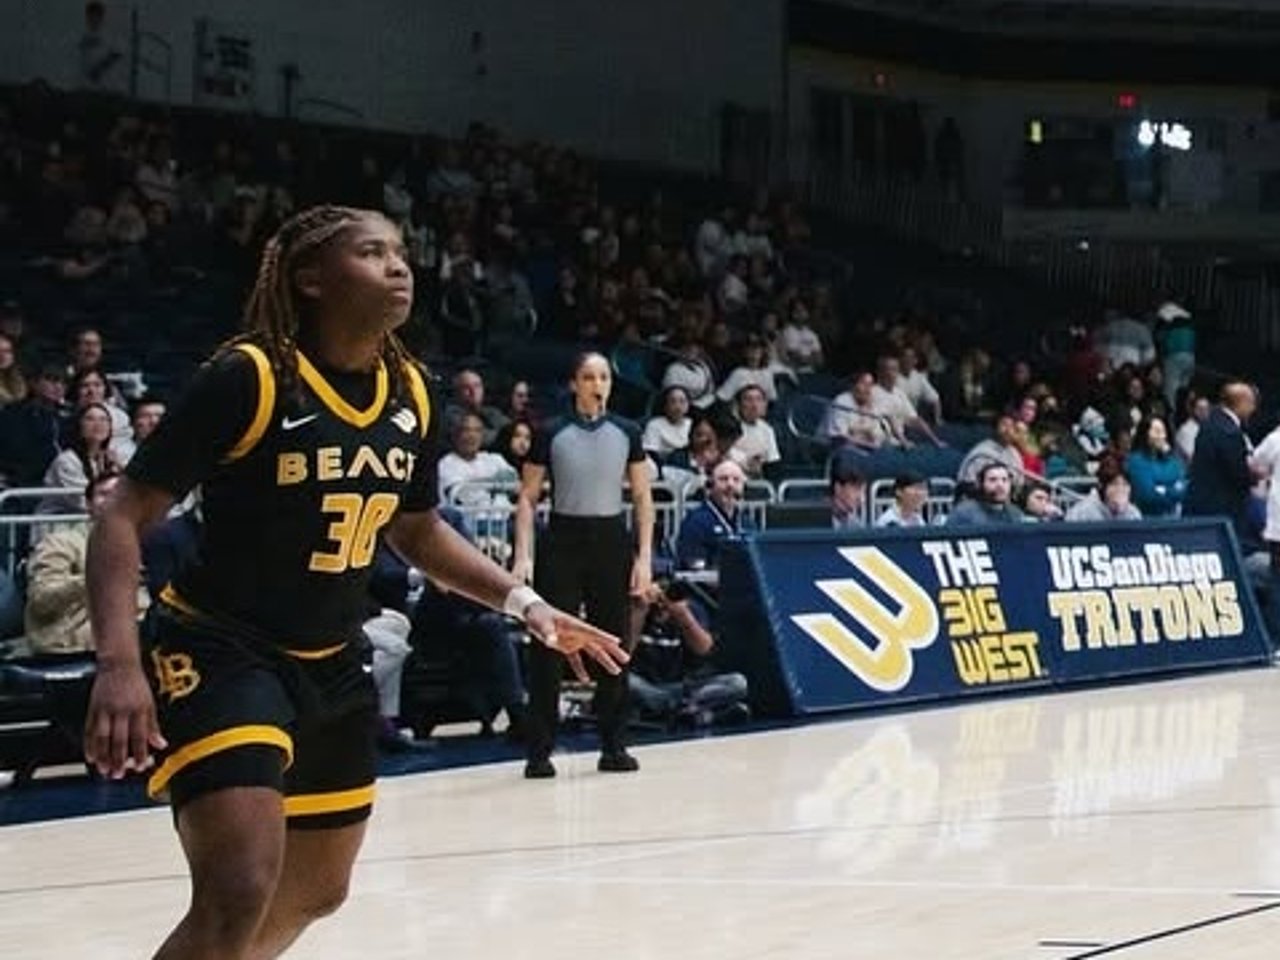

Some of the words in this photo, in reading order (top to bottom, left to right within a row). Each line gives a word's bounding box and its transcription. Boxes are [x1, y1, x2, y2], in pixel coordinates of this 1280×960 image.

[308, 492, 400, 574] 30
[921, 538, 999, 586] THE
[1047, 580, 1245, 652] TRITONS
[951, 631, 1043, 686] WEST
